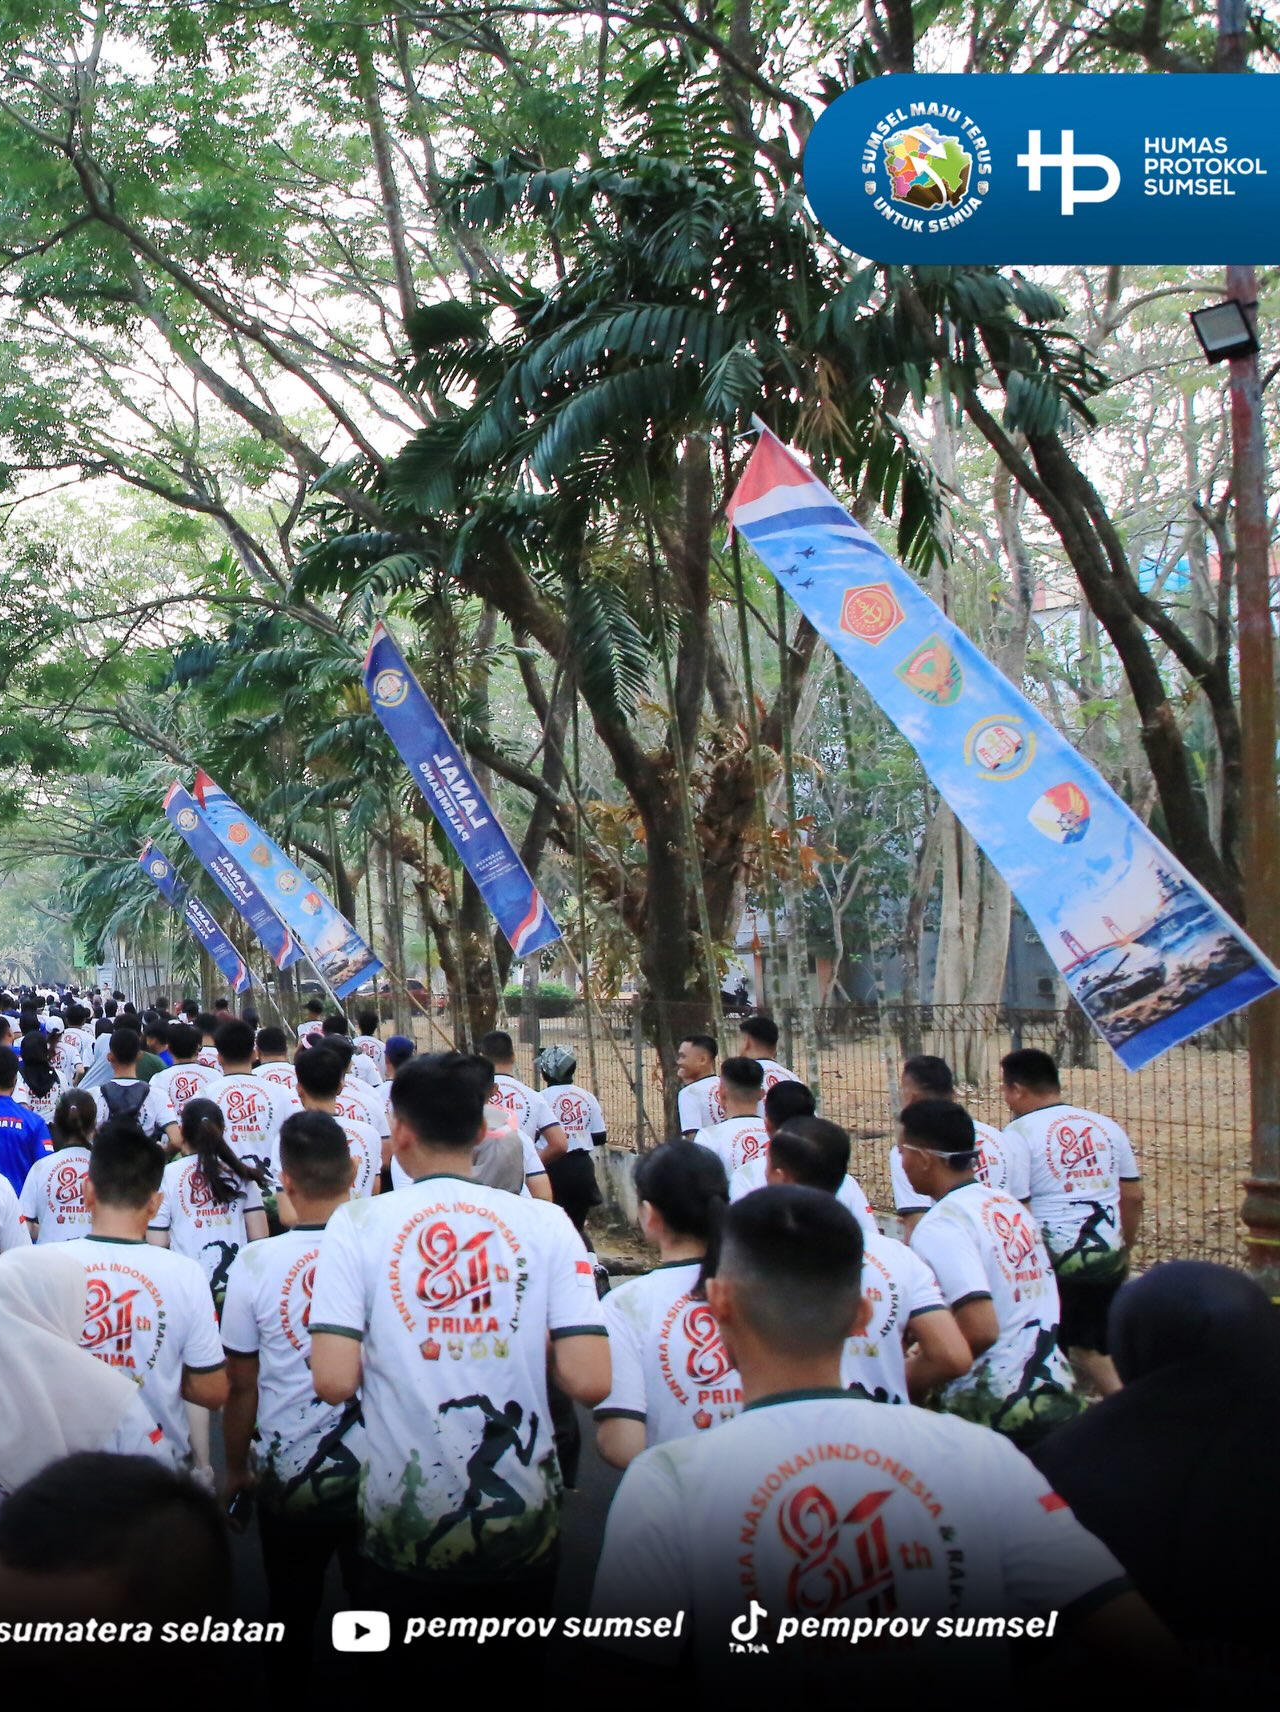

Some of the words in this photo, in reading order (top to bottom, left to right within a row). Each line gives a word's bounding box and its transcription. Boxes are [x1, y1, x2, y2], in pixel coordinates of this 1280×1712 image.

[231, 1124, 261, 1132] PRIMA
[392, 1202, 449, 1255] NASIONAL
[452, 1202, 521, 1254] INDONESIA
[110, 1262, 164, 1308] INDONESIA
[515, 1257, 527, 1268] &
[157, 1310, 166, 1319] &
[389, 1259, 416, 1333] TENTARA
[879, 1294, 899, 1338] RAKYAT
[147, 1322, 167, 1370] RAKYAT
[427, 1316, 499, 1334] PRIMA
[658, 1343, 689, 1405] TENTARA
[819, 1443, 943, 1518] INDONESIA
